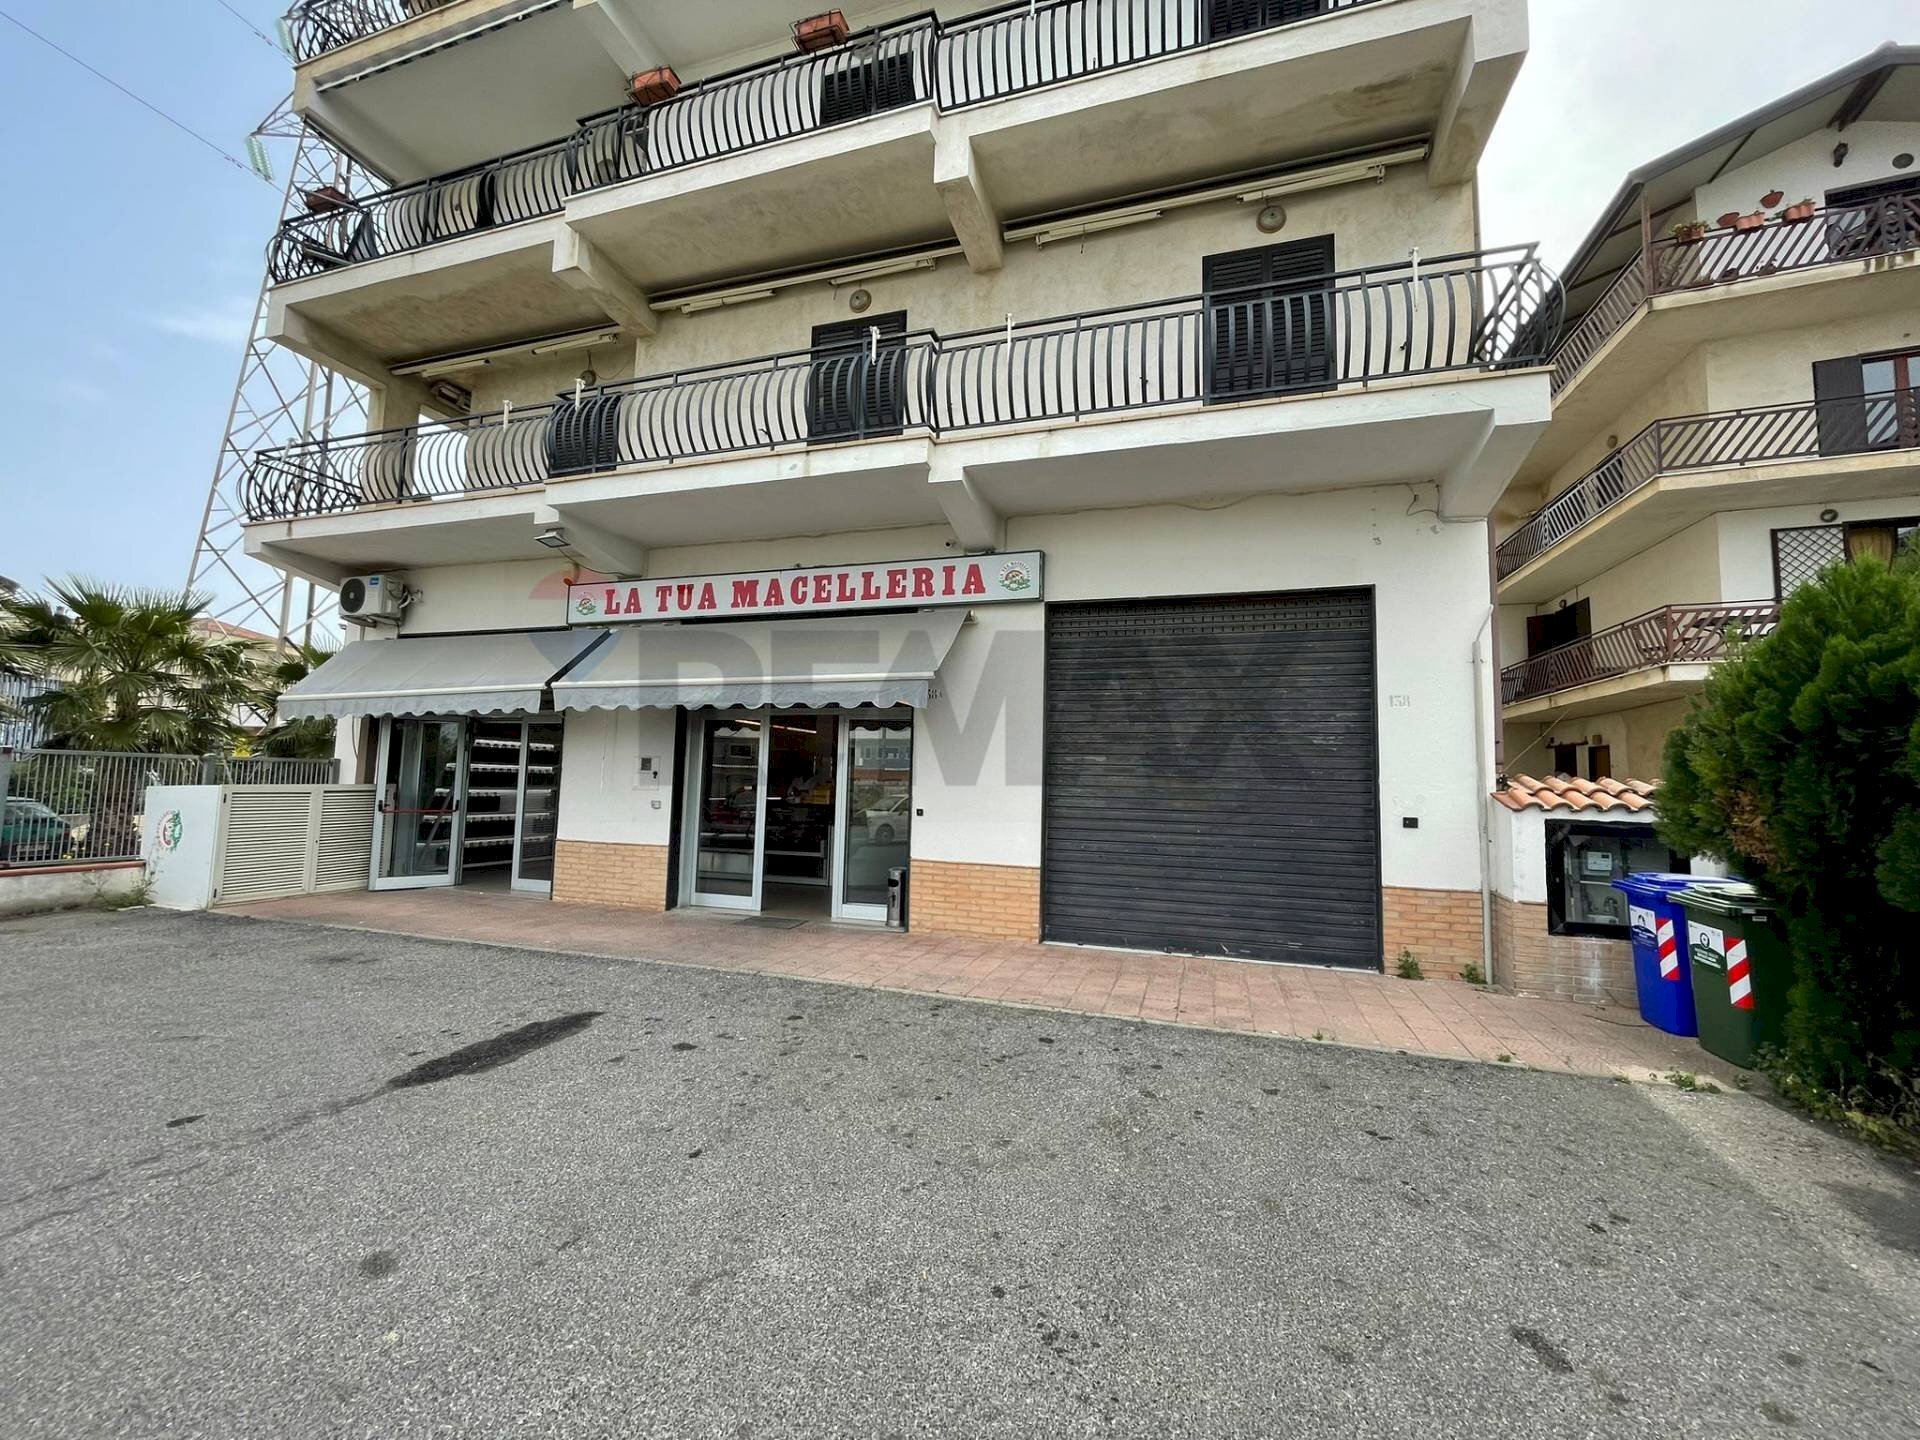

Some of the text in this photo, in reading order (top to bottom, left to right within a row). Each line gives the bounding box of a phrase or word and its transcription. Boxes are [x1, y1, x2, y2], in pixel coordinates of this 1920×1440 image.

[604, 587, 642, 615] LA
[655, 582, 717, 613] TUA
[730, 564, 987, 609] MACELLERIA
